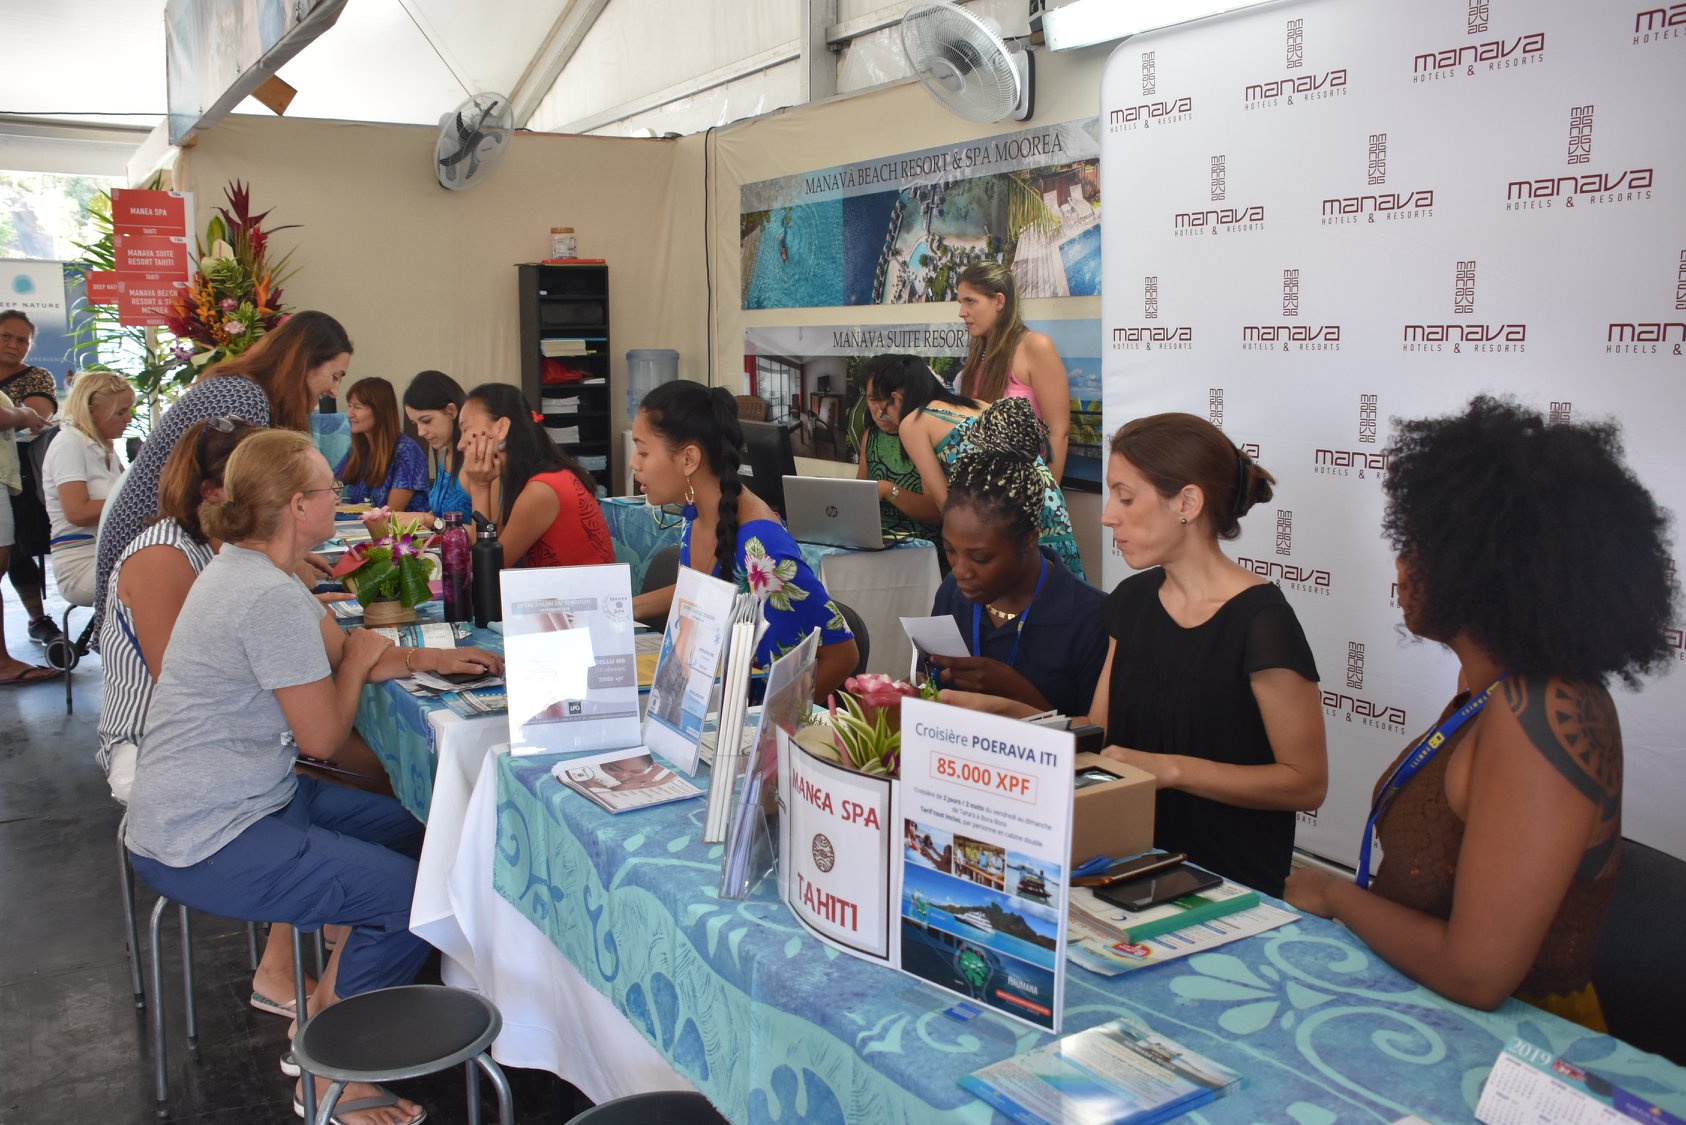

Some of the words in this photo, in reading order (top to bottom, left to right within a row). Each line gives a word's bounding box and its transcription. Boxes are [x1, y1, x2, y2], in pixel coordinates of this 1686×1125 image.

[1414, 32, 1545, 73] manava
[1413, 69, 1455, 84] HOTELS
[1467, 65, 1475, 76] &
[1489, 53, 1544, 71] RESORTS
[1245, 69, 1347, 102] manava
[1245, 99, 1278, 111] HOTELS
[1287, 95, 1294, 105] &
[1304, 87, 1347, 101] RESORTS
[1110, 97, 1192, 125] manava
[1110, 123, 1137, 133] HOTELS
[1144, 119, 1150, 129] &
[1158, 113, 1192, 125] RESORTS
[858, 162, 899, 186] BEACH
[900, 153, 949, 179] RESORT
[952, 151, 963, 170] &
[965, 146, 991, 168] SPA
[994, 132, 1063, 163] MOOREA
[1507, 168, 1653, 200] manava
[1322, 190, 1433, 216] manava
[1506, 199, 1552, 211] HOTELS
[1566, 197, 1574, 208] &
[1590, 190, 1651, 205] RESORTS
[1175, 206, 1264, 228] manava
[1321, 215, 1358, 225] HOTELS
[1367, 212, 1375, 223] &
[1386, 209, 1433, 221] RESORTS
[1175, 227, 1204, 237] HOTELS
[1211, 225, 1218, 235] &
[1227, 223, 1264, 232] RESORTS
[127, 249, 154, 257] MANAVA
[155, 250, 174, 258] SUITE
[154, 258, 174, 266] TAHITI
[832, 331, 884, 348] MANAVA
[887, 330, 921, 348] SUITE
[1113, 327, 1192, 341] manava
[1243, 325, 1340, 341] manava
[1404, 324, 1526, 342] manava
[1146, 342, 1151, 351] &
[1243, 343, 1274, 351] HOTELS
[1283, 342, 1289, 352] &
[1300, 343, 1340, 351] RESORTS
[1403, 343, 1442, 352] HOTELS
[1453, 342, 1461, 353] &
[1474, 344, 1525, 353] RESORTS
[1606, 344, 1657, 354] HOTELS
[1673, 344, 1682, 356] &
[1314, 466, 1349, 477] HOTELS
[1358, 469, 1366, 480] &
[1238, 557, 1330, 586] manava
[1291, 582, 1330, 596] RESORTS
[1346, 713, 1352, 722] &
[1363, 718, 1405, 735] RESORTS
[915, 722, 969, 747] Croisière
[972, 735, 1036, 763] POERAVA
[1040, 751, 1058, 768] ITI
[937, 757, 991, 786] 85.000
[996, 771, 1030, 796] XPF
[792, 768, 834, 815] MANEA
[841, 799, 880, 831] SPA
[797, 872, 858, 932] TAHITI
[1507, 1037, 1552, 1066] 2019
